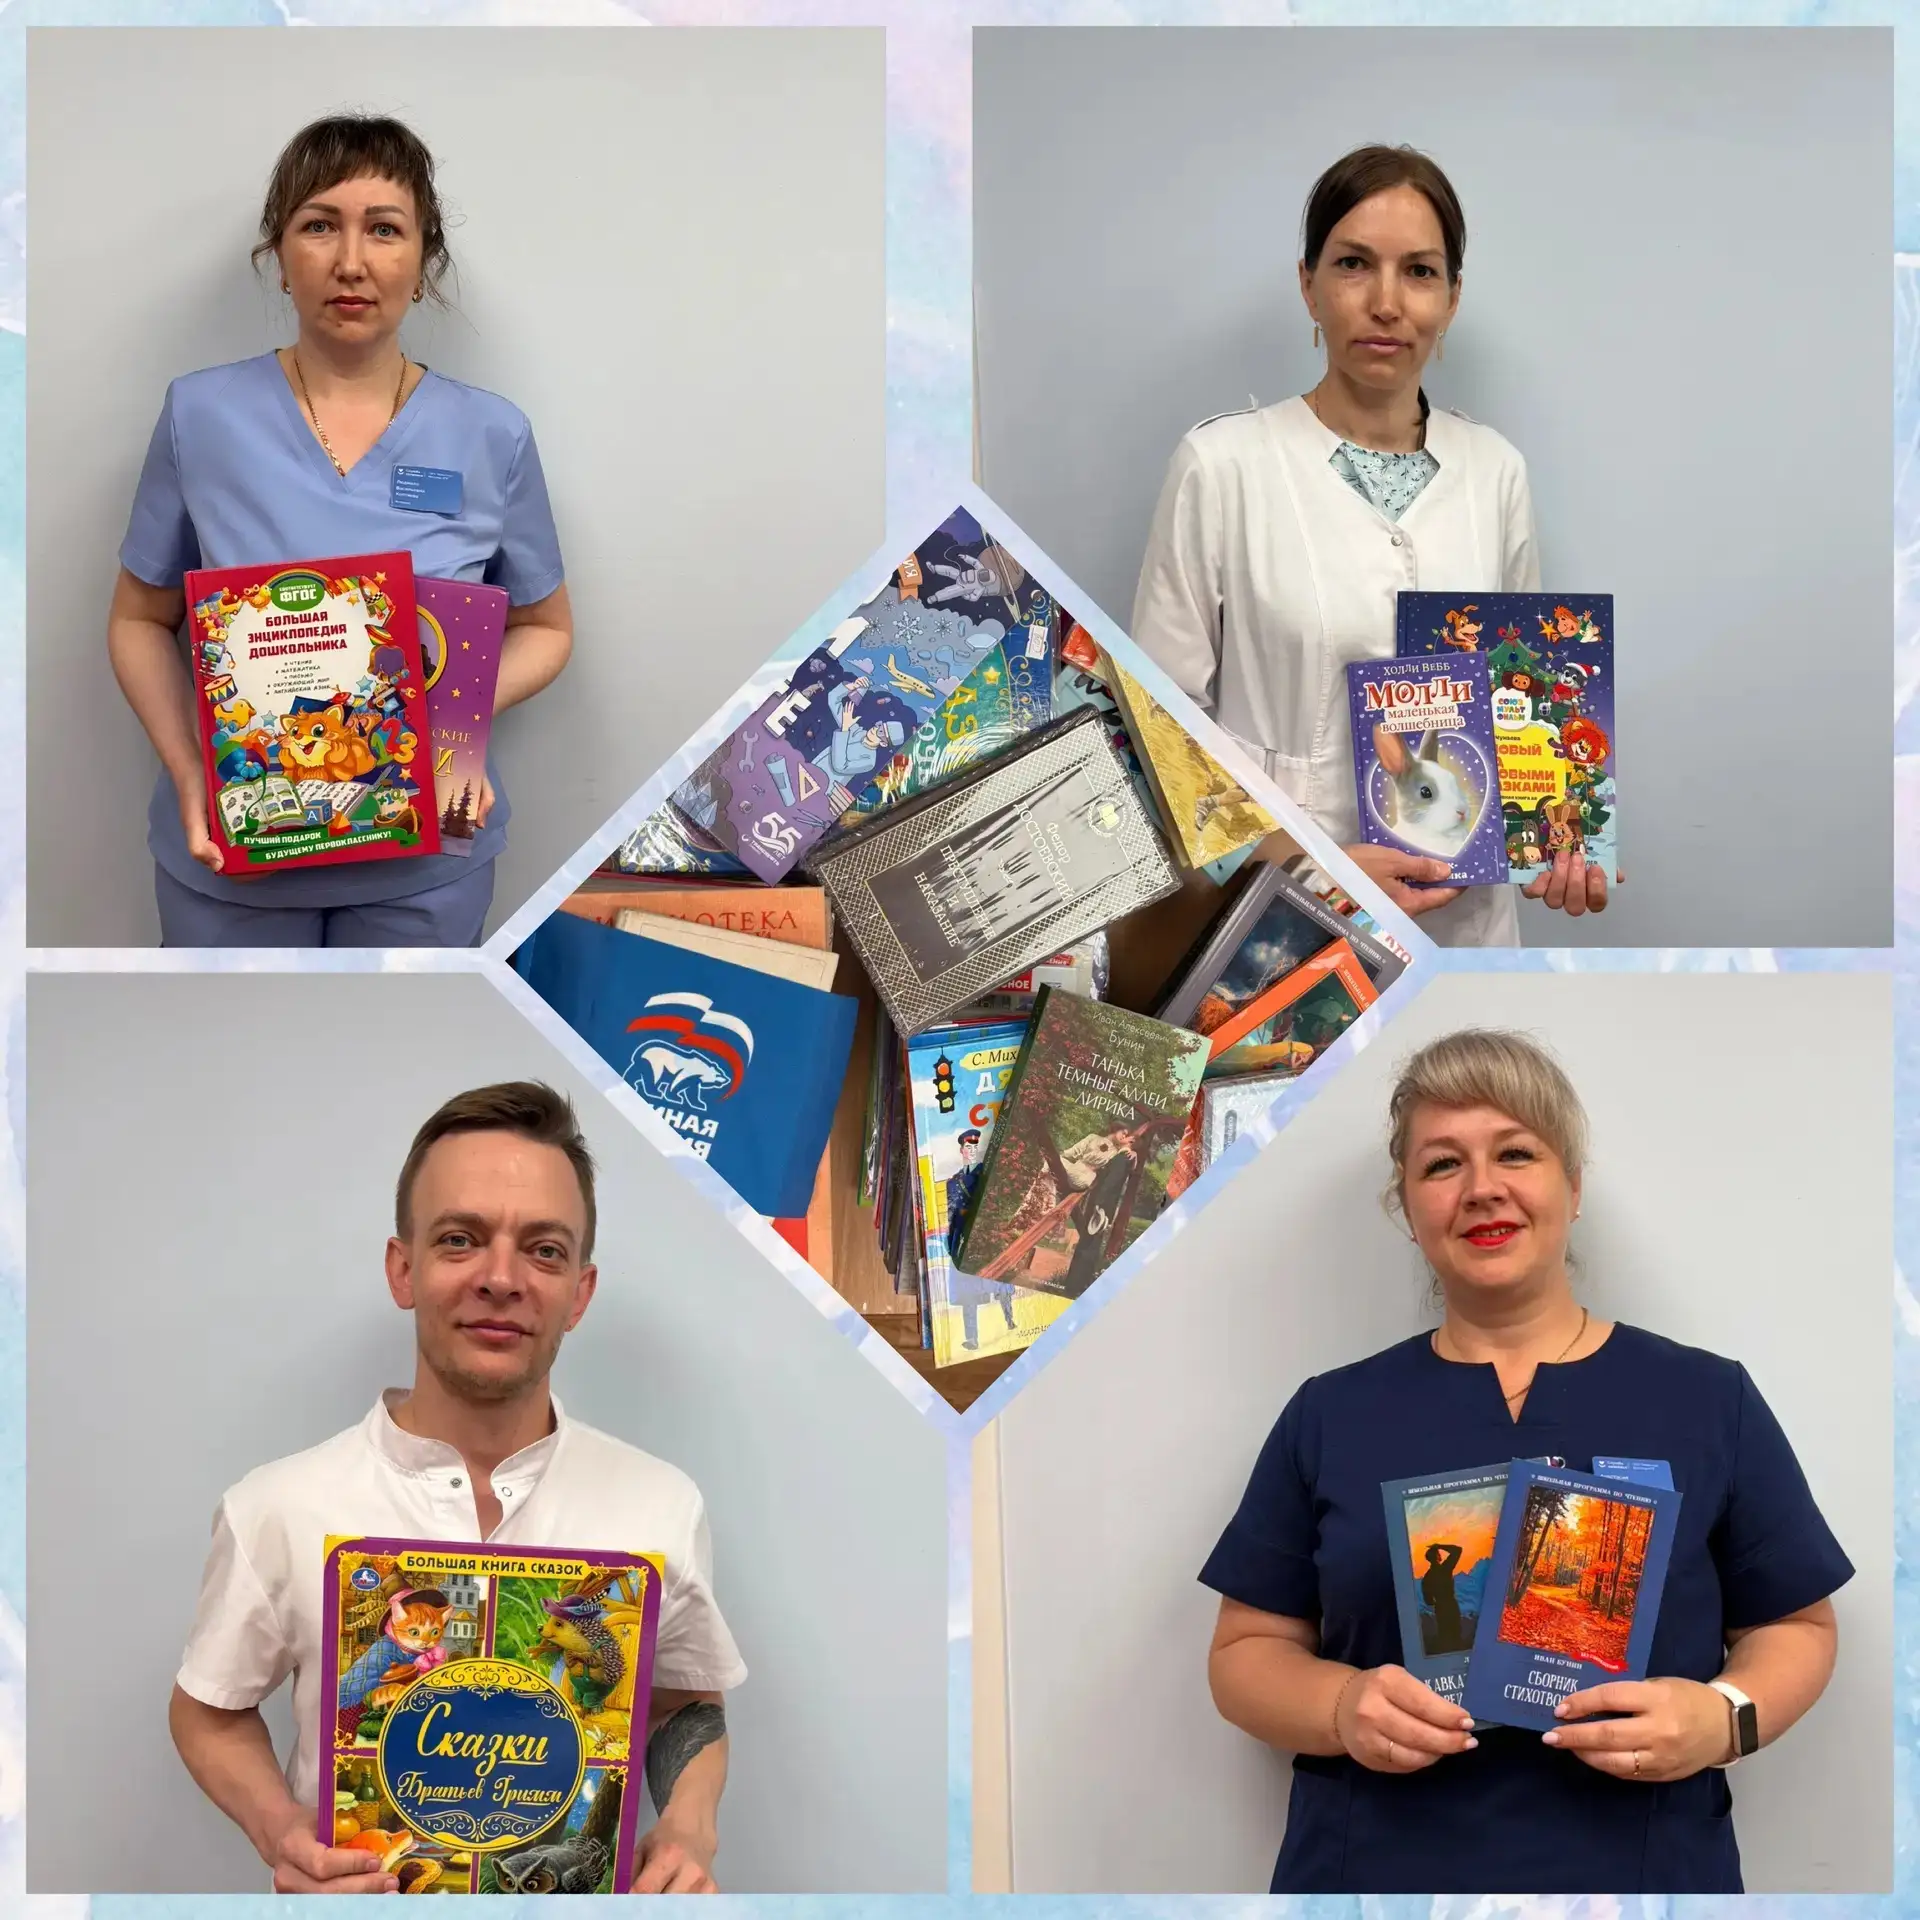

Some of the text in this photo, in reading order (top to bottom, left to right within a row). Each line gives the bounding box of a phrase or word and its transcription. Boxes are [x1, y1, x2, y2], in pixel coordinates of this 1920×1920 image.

[902, 558, 919, 578] ИЯ
[280, 588, 318, 602] ФГОС
[266, 611, 328, 627] БОЛЬШАЯ
[248, 624, 347, 644] ЭНЦИКЛОПЕДИЯ
[248, 638, 348, 660] ДОШКОЛЬНИКА
[1383, 662, 1450, 676] ХОЛЛИ ВЕББ
[1364, 676, 1474, 710] МОЛЛИ
[1498, 698, 1524, 706] СОЮЗ
[1388, 704, 1456, 718] маленькая
[1496, 706, 1526, 714] МУЛЬТ
[432, 728, 473, 742] СКИЕ
[1382, 718, 1464, 732] волшебница
[433, 746, 458, 778] И
[1499, 769, 1556, 781] ОВЫМИ
[244, 832, 322, 844] ЛУЧШИЙ ПОДАРОК
[752, 812, 803, 855] 55
[266, 830, 392, 860] БУДУЩЕМУ ПЕРВОКЛАССНИКУ!
[1013, 802, 1076, 902] ДОСТОЕВСКИЙ
[940, 844, 998, 942] ПРЕСТУПЛЕНИЕ
[914, 872, 962, 948] НАКАЗАНИЕ
[1316, 908, 1350, 938] ПРОГРАММА
[1350, 934, 1359, 944] ПО
[1092, 1012, 1117, 1026] Иван
[1108, 1030, 1146, 1052] Бунин
[972, 1050, 1018, 1066] С. Мих
[1090, 1052, 1145, 1084] ТАНЬКА
[976, 1069, 1014, 1096] ДЯ
[1058, 1062, 1168, 1110] ТЕМНЫЕ АЛЛЕИ
[968, 1101, 1003, 1128] СТ
[1074, 1091, 1136, 1120] ЛИРИКА
[1443, 1478, 1482, 1488] ПРОГРАММА
[1573, 1482, 1611, 1495] ПРОГРАММА
[406, 1556, 584, 1576] БОЛЬШАЯ КНИГА СКАЗОК
[1534, 1654, 1583, 1670] ИВАН БУНИН
[1424, 1673, 1467, 1692] КАВКА
[1528, 1670, 1579, 1693] СБОРНИК
[416, 1701, 548, 1777] Сказки
[396, 1770, 563, 1809] Братьев Гримм
